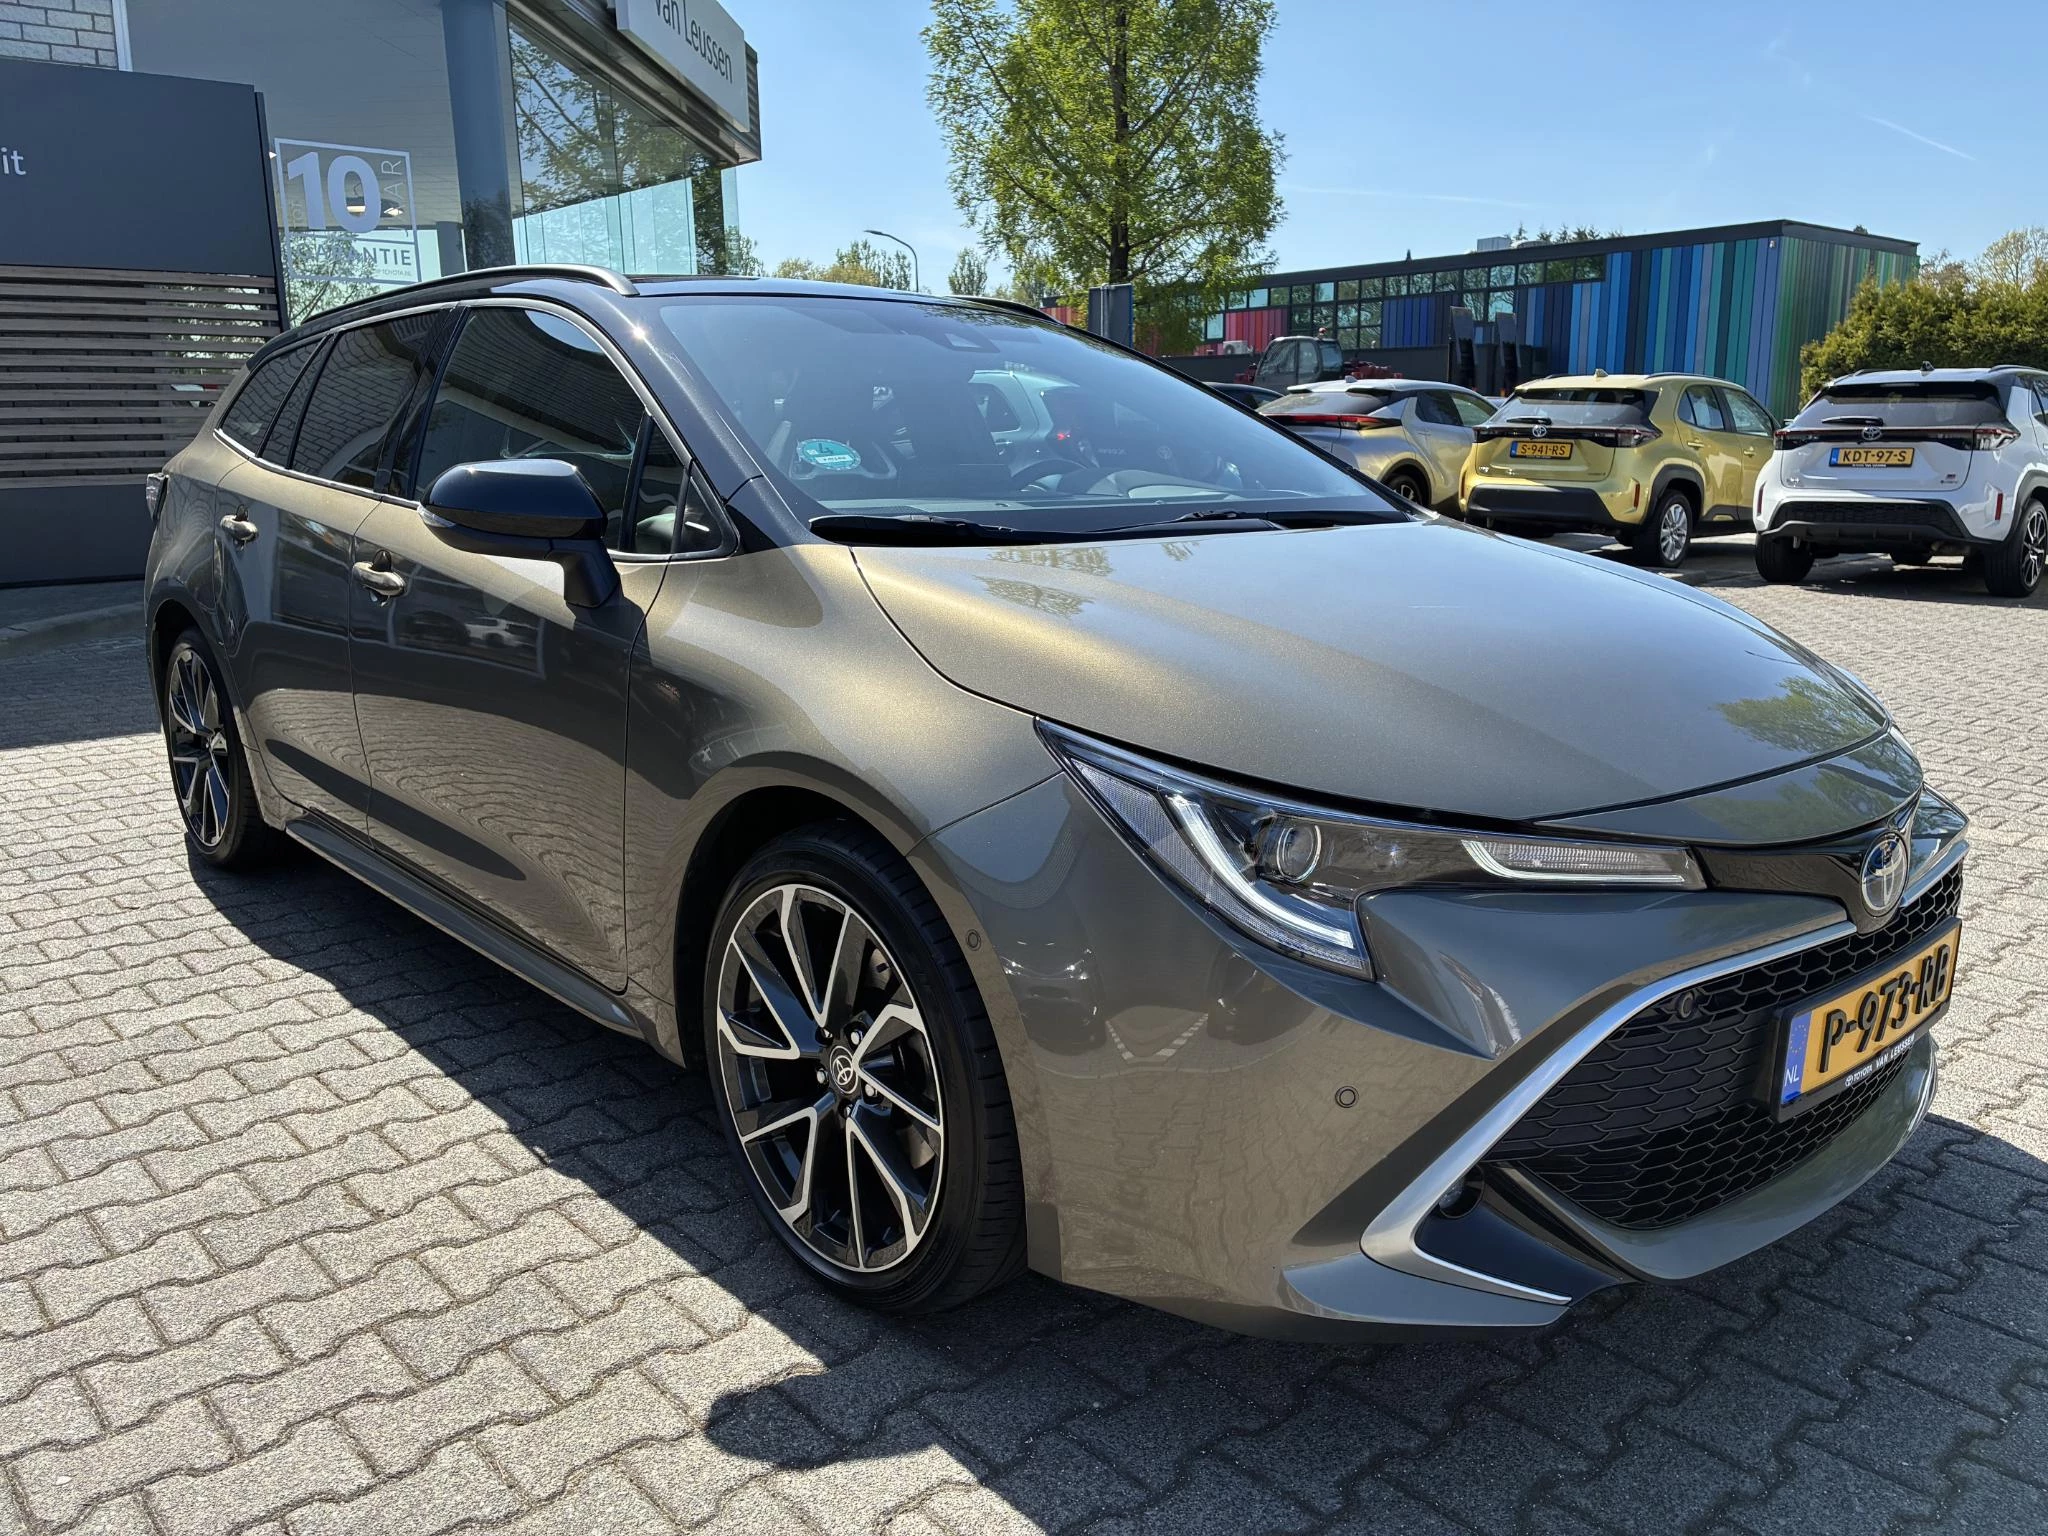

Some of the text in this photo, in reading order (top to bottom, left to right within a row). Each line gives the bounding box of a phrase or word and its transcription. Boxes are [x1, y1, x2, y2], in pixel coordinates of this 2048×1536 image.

[683, 0, 733, 84] Leussen
[287, 151, 381, 234] 10
[1520, 444, 1566, 456] S-941-RS
[1842, 450, 1907, 463] KDT-97-S
[1818, 943, 1951, 1074] P-973-RB
[1784, 1064, 1800, 1087] NL
[1853, 1032, 1915, 1081] TOYOTA VAN LEUSSEN
